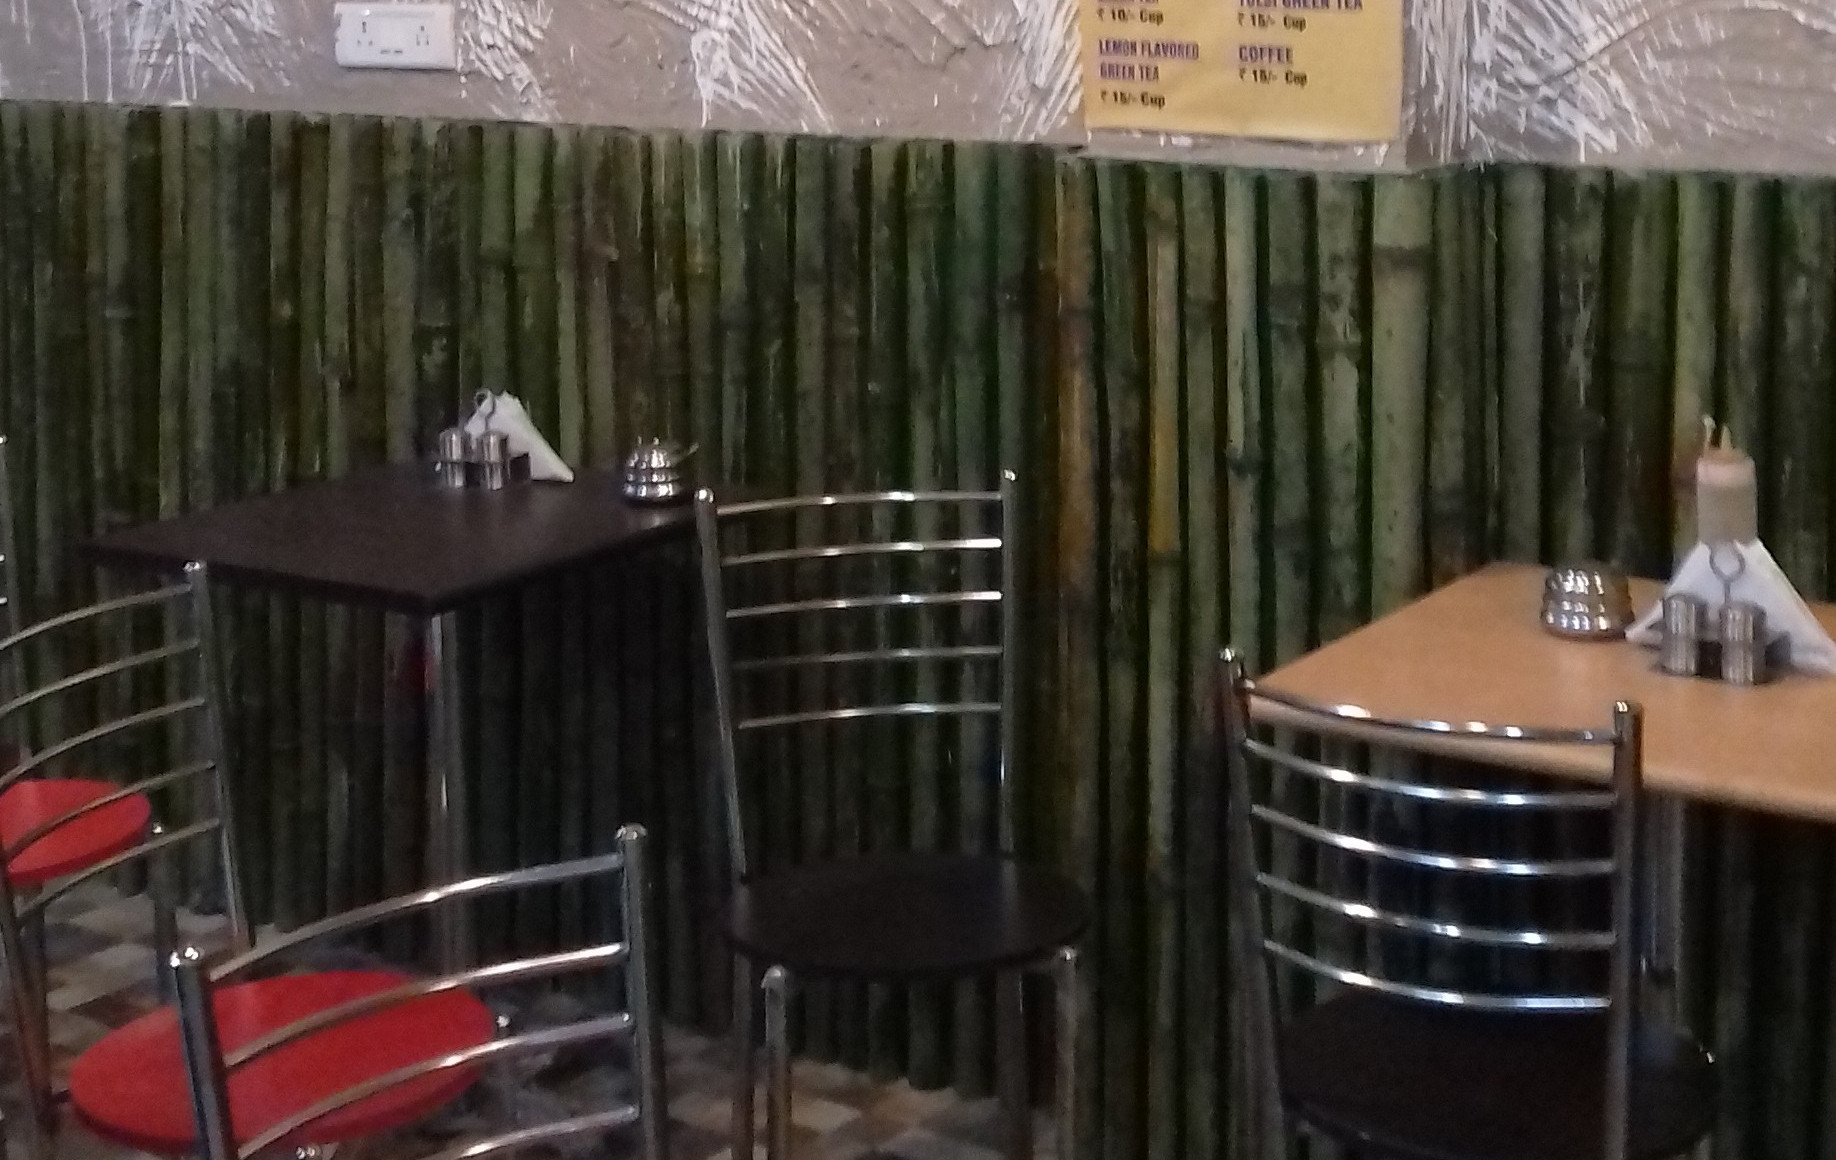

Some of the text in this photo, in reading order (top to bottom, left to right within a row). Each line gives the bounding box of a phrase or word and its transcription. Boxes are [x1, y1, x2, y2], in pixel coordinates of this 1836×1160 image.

[1140, 9, 1163, 26] Cup
[1283, 15, 1306, 31] Cup
[1099, 40, 1138, 58] LEMON
[1239, 47, 1293, 64] COFFEE
[1100, 64, 1159, 82] GREEN TEA
[1285, 71, 1307, 86] Cup
[1140, 91, 1165, 109] Cup
